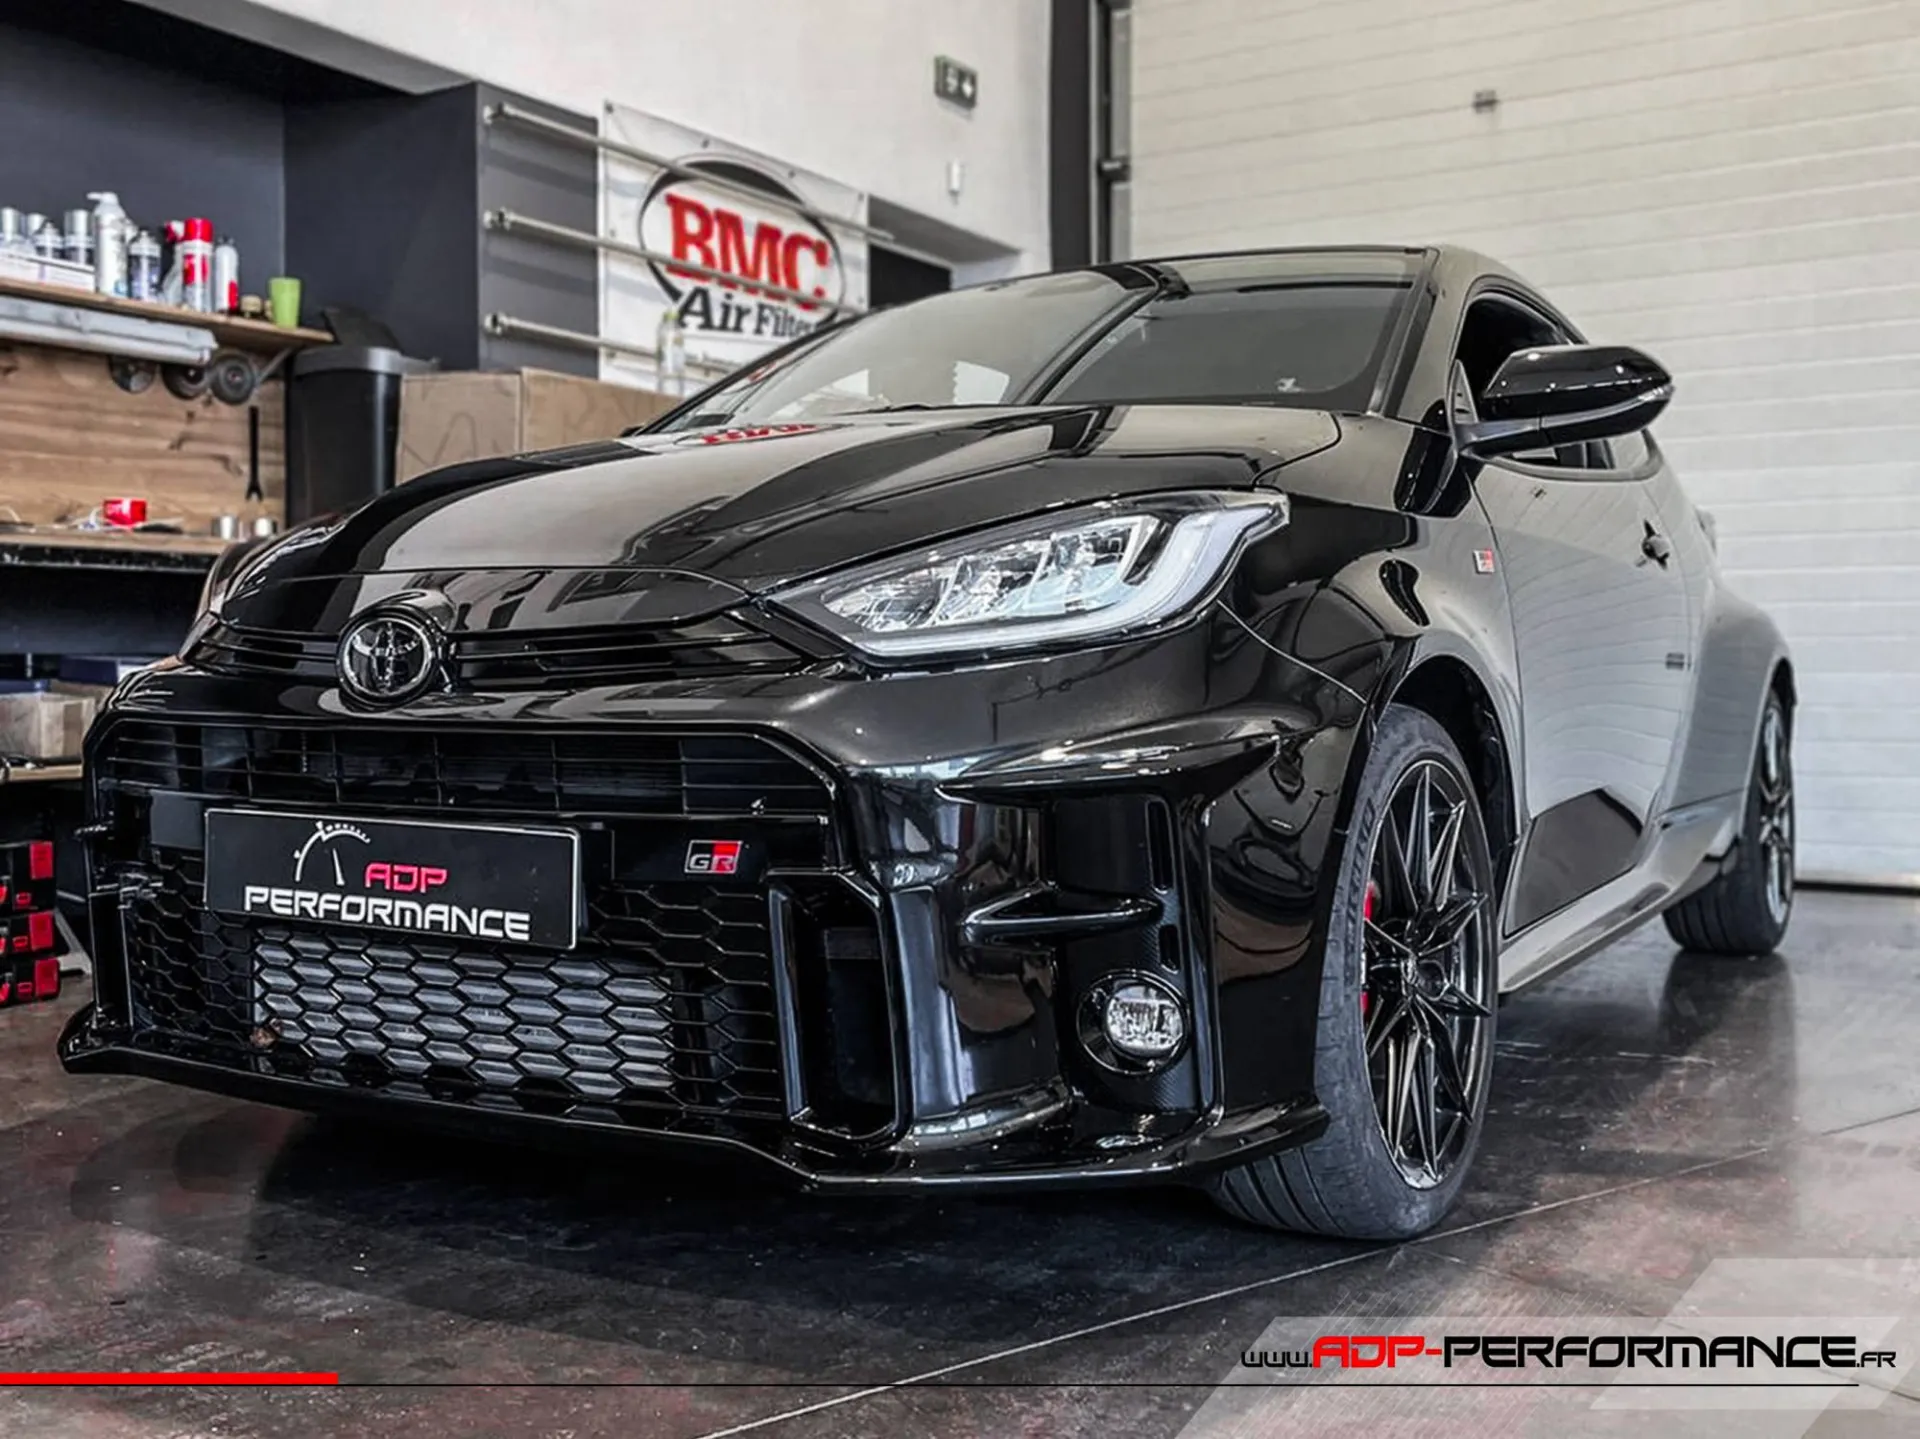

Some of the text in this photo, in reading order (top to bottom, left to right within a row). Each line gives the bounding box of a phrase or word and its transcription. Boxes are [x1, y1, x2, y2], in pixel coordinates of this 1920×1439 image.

[677, 286, 752, 334] Air
[365, 861, 448, 893] ADP
[688, 853, 736, 872] GR
[243, 885, 531, 941] PERFORMANCE
